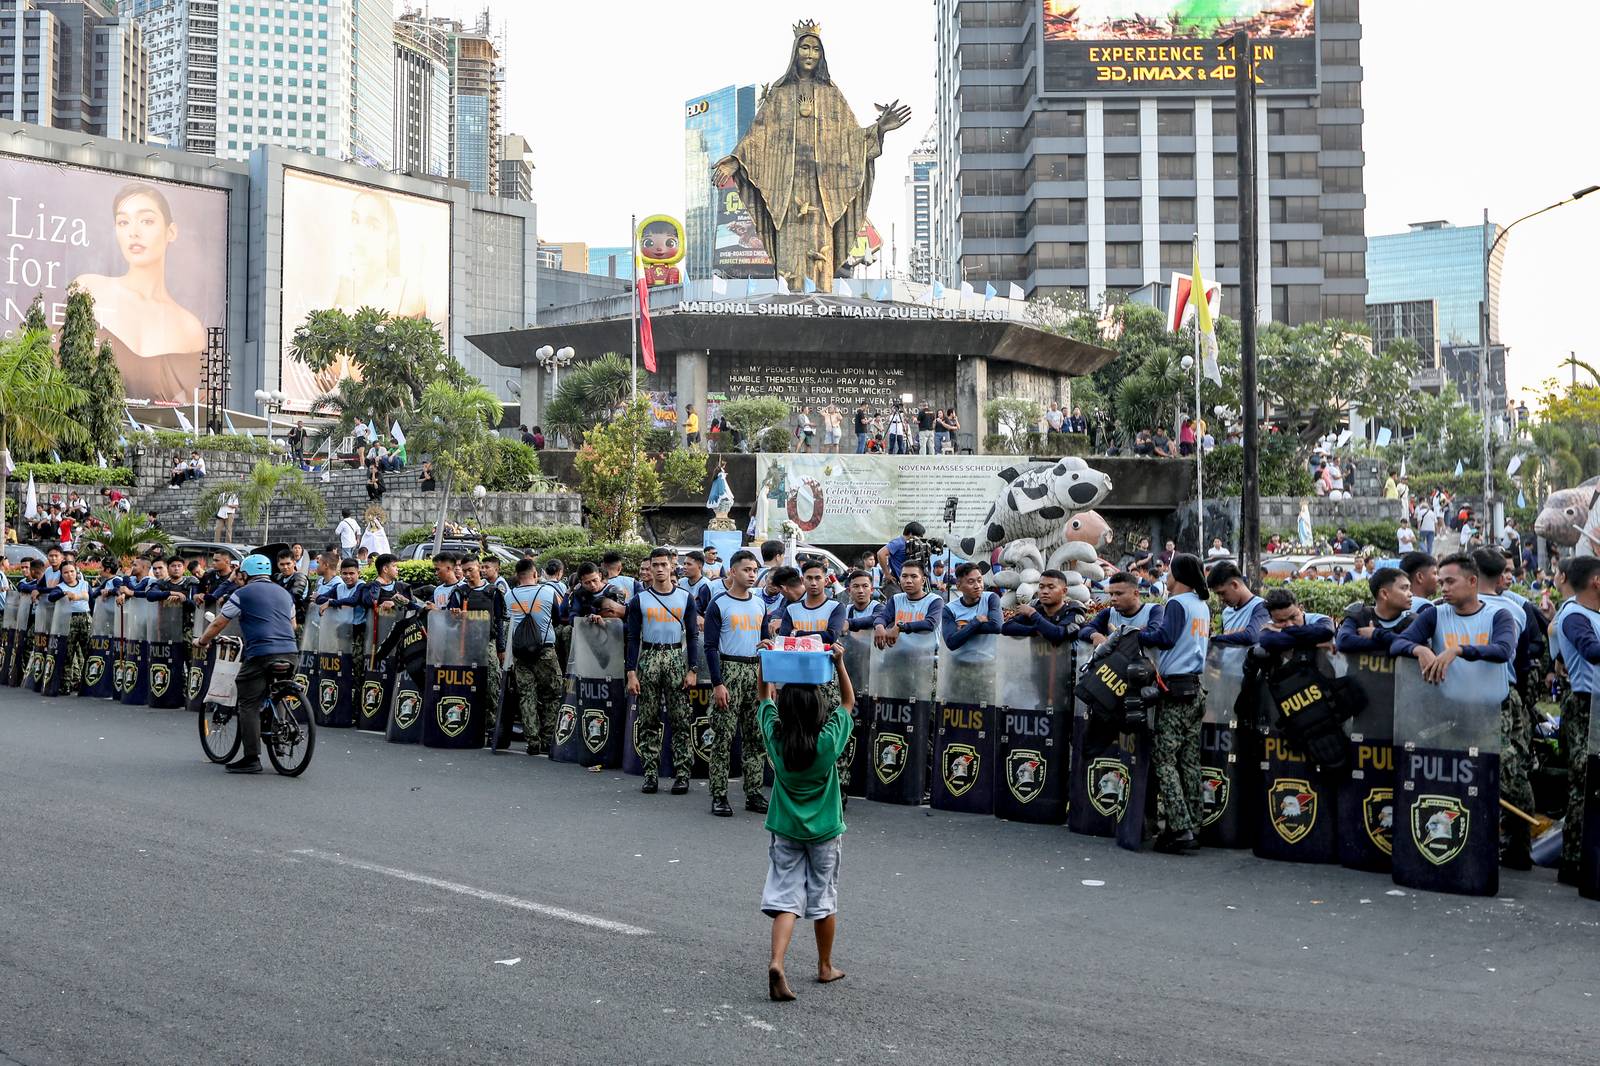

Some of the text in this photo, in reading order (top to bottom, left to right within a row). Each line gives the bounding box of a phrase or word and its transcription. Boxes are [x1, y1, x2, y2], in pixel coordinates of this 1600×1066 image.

[1090, 46, 1204, 62] EXPERIENCE
[1254, 46, 1274, 60] IN
[1198, 68, 1206, 80] &
[688, 100, 710, 118] BDO
[6, 196, 90, 247] Liza
[6, 244, 60, 288] for
[678, 300, 1009, 321] NATIONAL SHRINE OF MARY, QUEEN OF PEACE
[878, 378, 897, 386] SEK
[826, 488, 878, 496] Celebrating
[826, 497, 895, 505] Faith, Freedom,
[404, 632, 422, 648] PULIS
[150, 645, 170, 658] PULIS
[320, 656, 340, 670] PULIS
[1360, 654, 1394, 673] PULI
[438, 670, 474, 686] PULIS
[1096, 664, 1128, 697] PULIS
[580, 682, 610, 700] PULIS
[1280, 684, 1322, 717] PULIS
[874, 703, 912, 724] PULIS
[942, 708, 984, 730] PULIS
[1006, 714, 1050, 736] PULIS
[1204, 730, 1232, 751] LIS
[1358, 746, 1394, 770] PUL
[1410, 756, 1474, 784] PULIS
